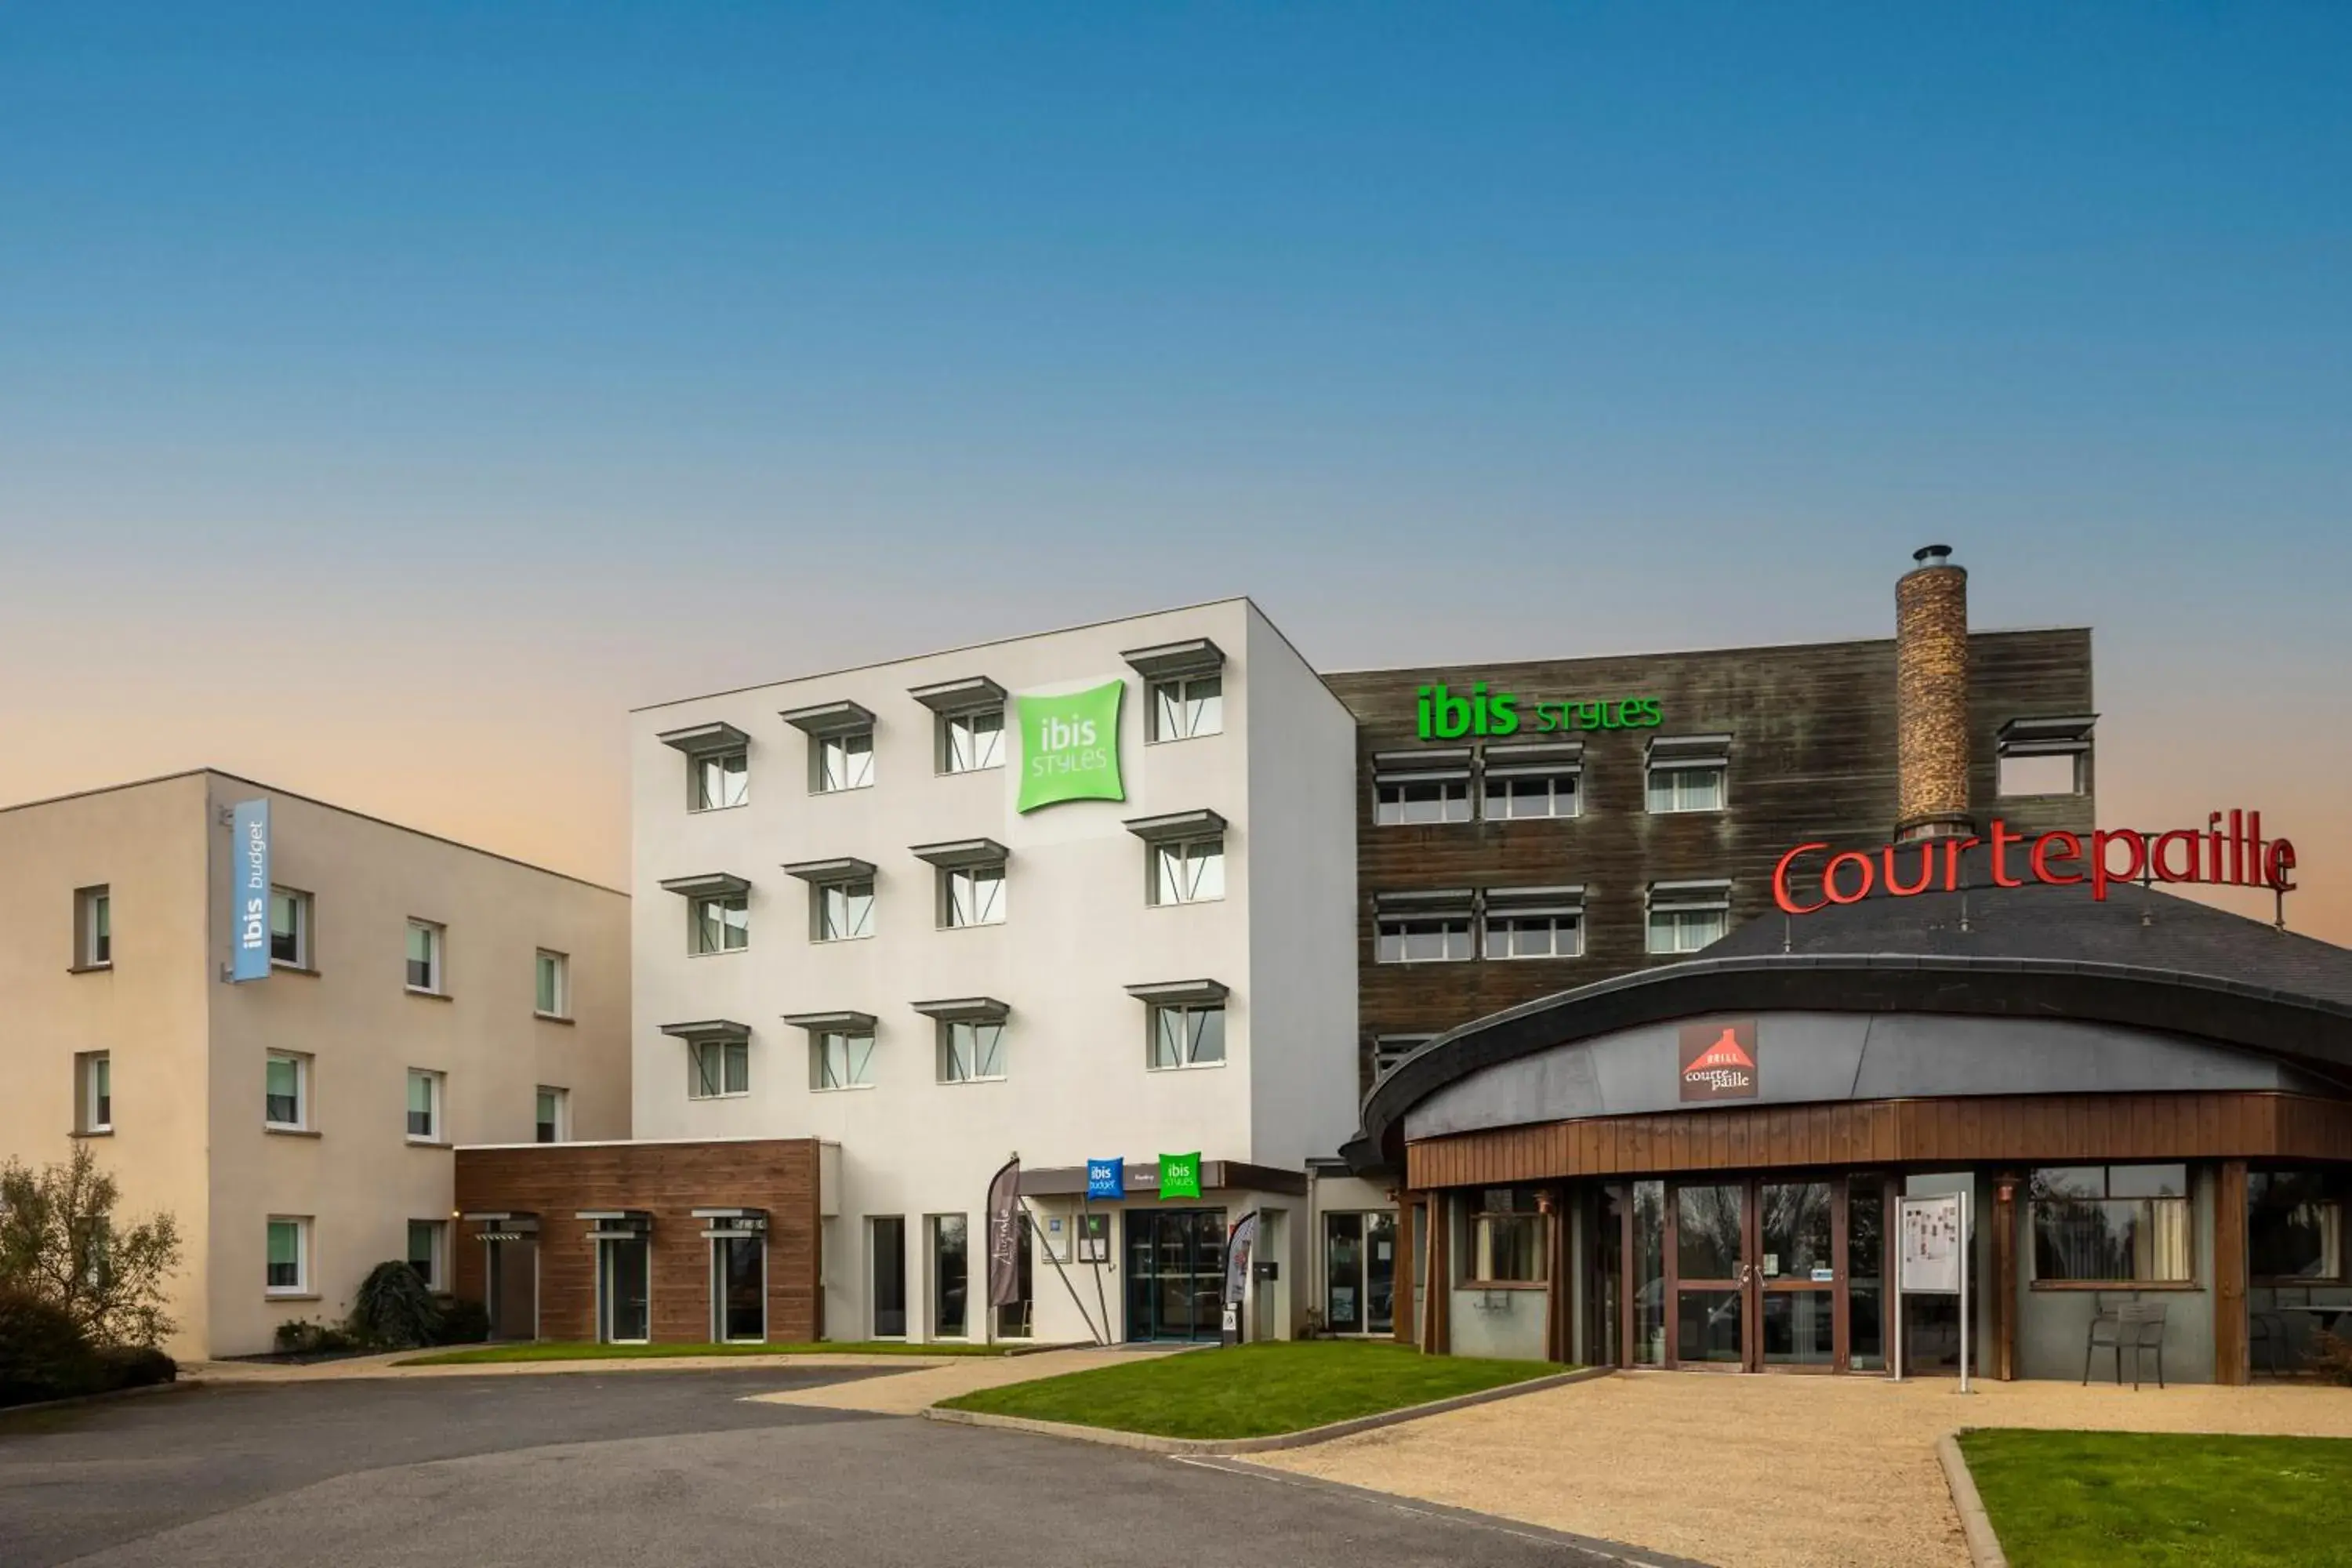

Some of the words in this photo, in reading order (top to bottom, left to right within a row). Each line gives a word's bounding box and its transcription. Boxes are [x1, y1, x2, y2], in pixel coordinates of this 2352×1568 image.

[1041, 713, 1097, 752] ibis
[1417, 681, 1519, 739] ibis
[248, 820, 266, 890] budget
[1772, 808, 2296, 914] Courtepaille
[244, 897, 263, 950] ibis
[1091, 1166, 1111, 1179] ibis
[1168, 1163, 1190, 1177] ibis
